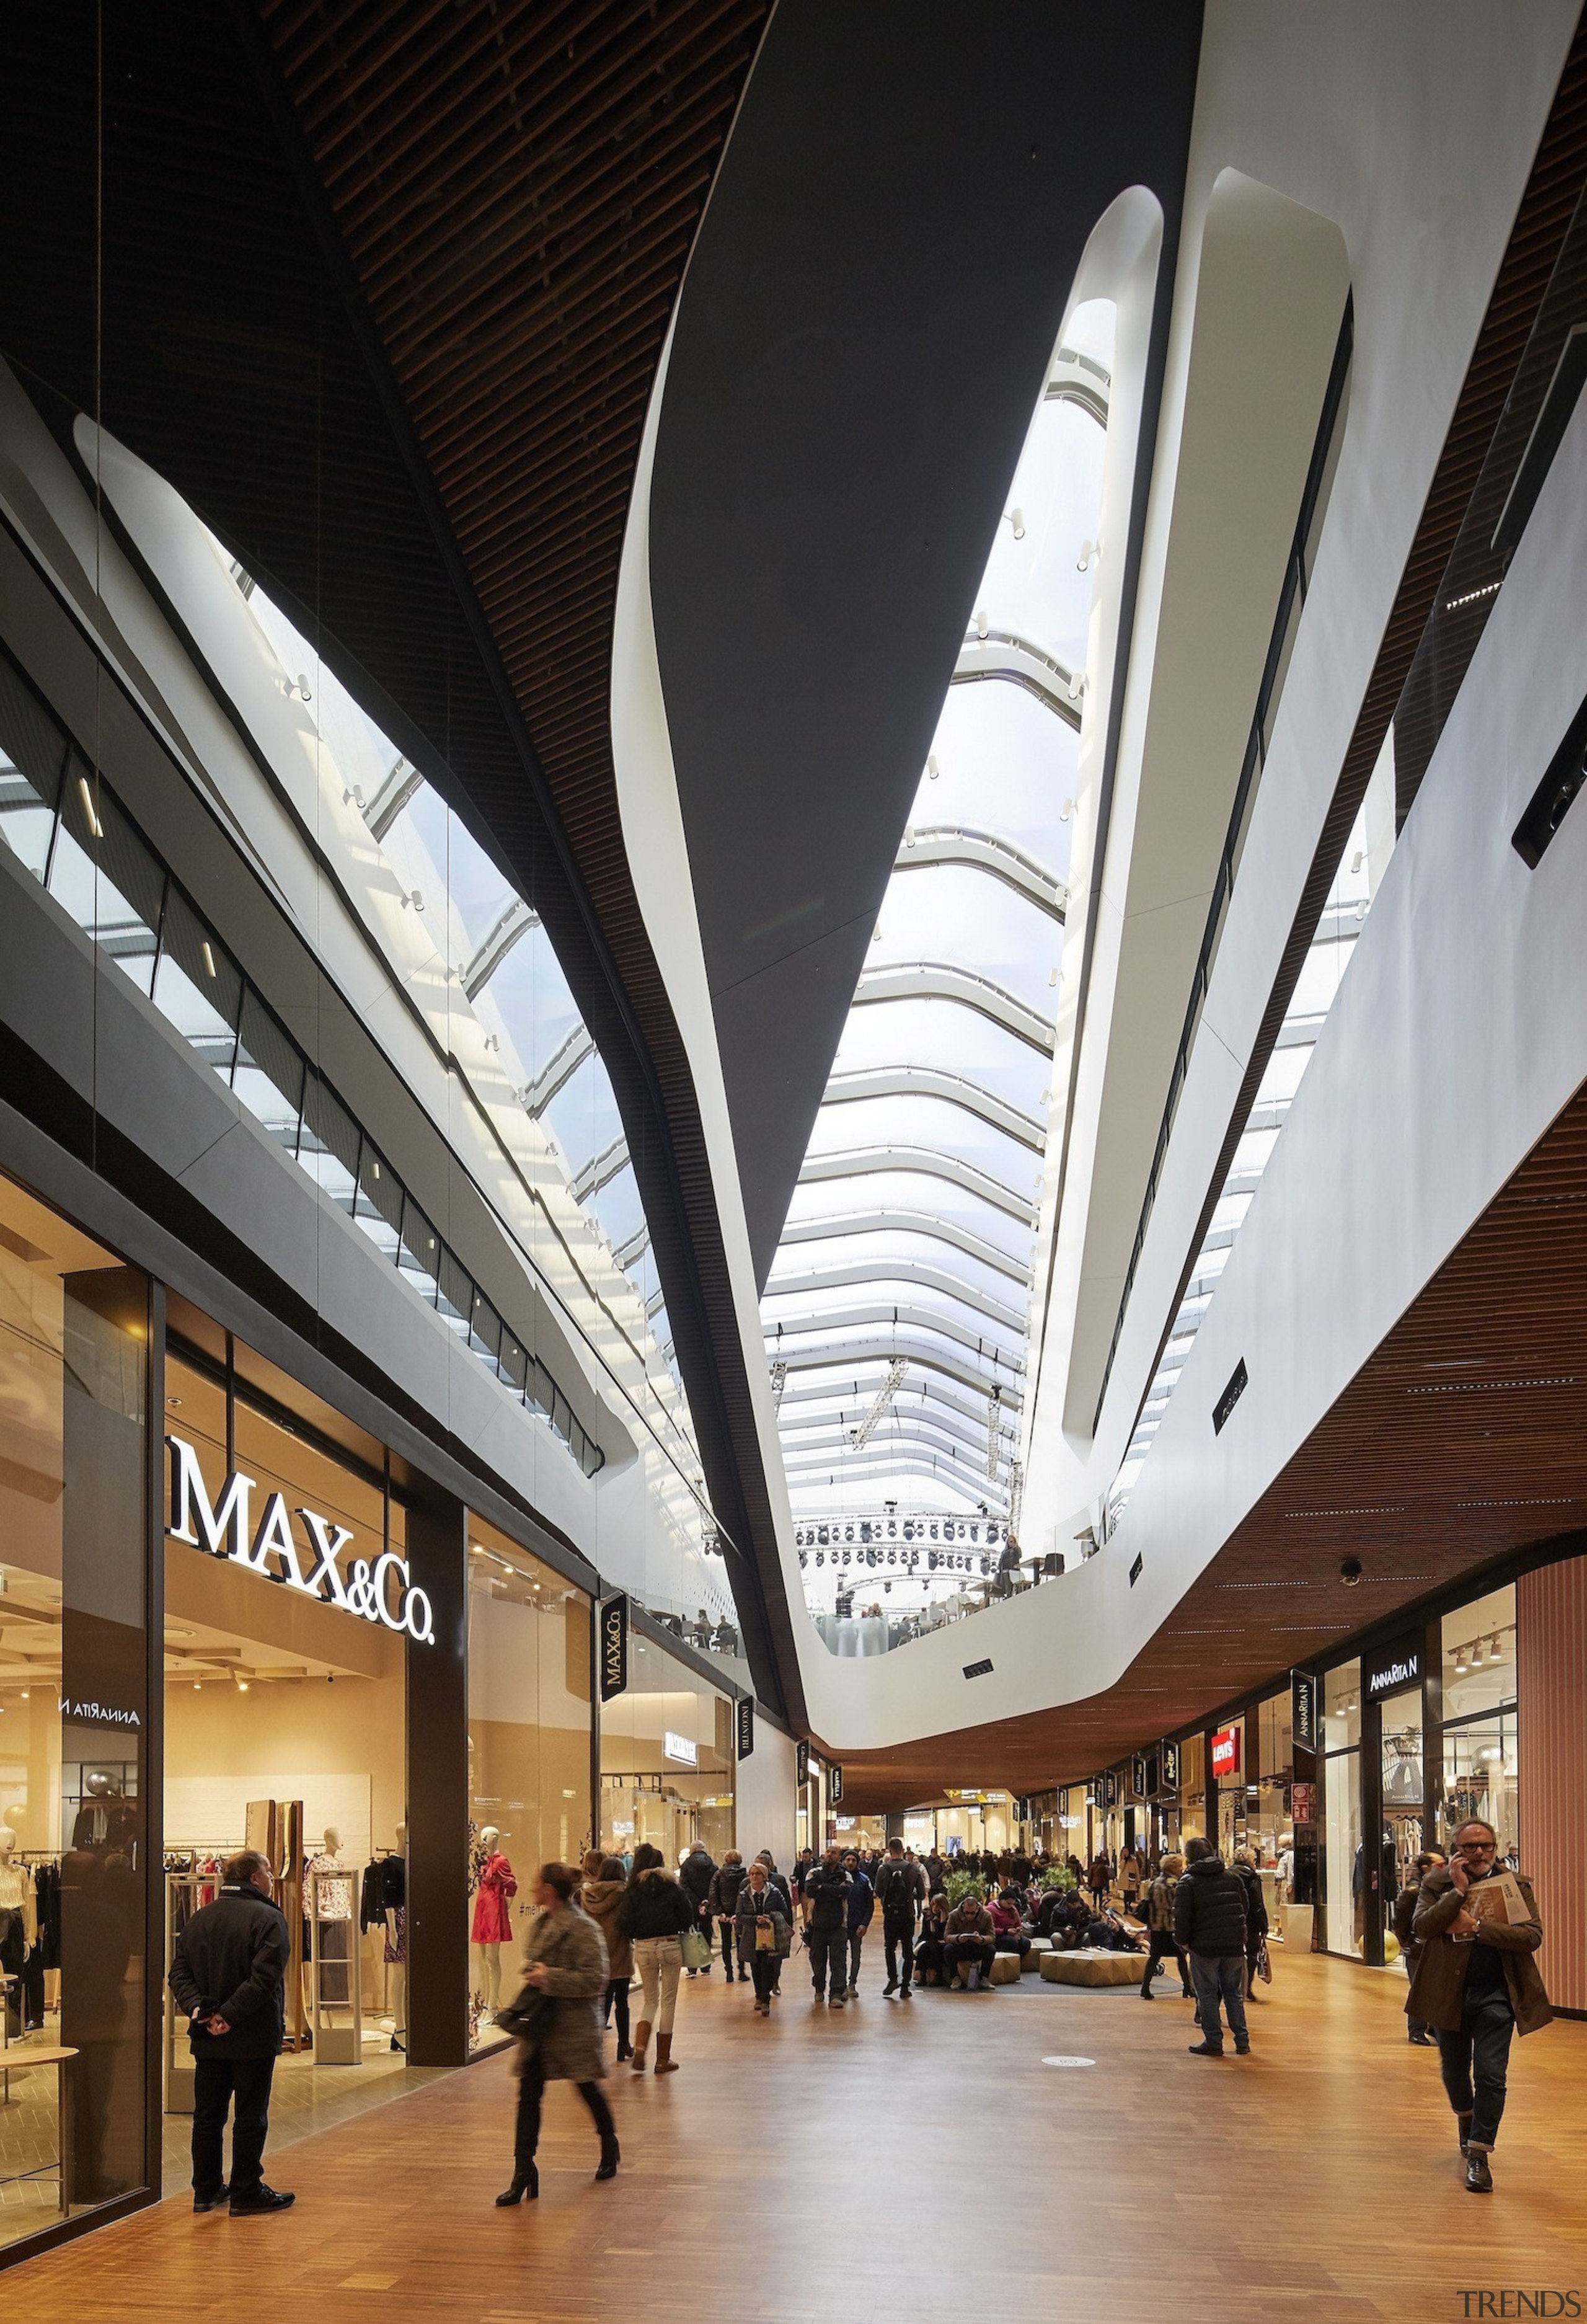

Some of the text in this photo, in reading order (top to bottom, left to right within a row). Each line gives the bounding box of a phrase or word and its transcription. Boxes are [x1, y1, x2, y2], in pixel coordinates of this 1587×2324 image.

[169, 1434, 435, 1646] MAX&Co.
[1408, 1655, 1417, 1677] N
[1299, 1684, 1308, 1693] N
[741, 1706, 749, 1749] INCONTRI
